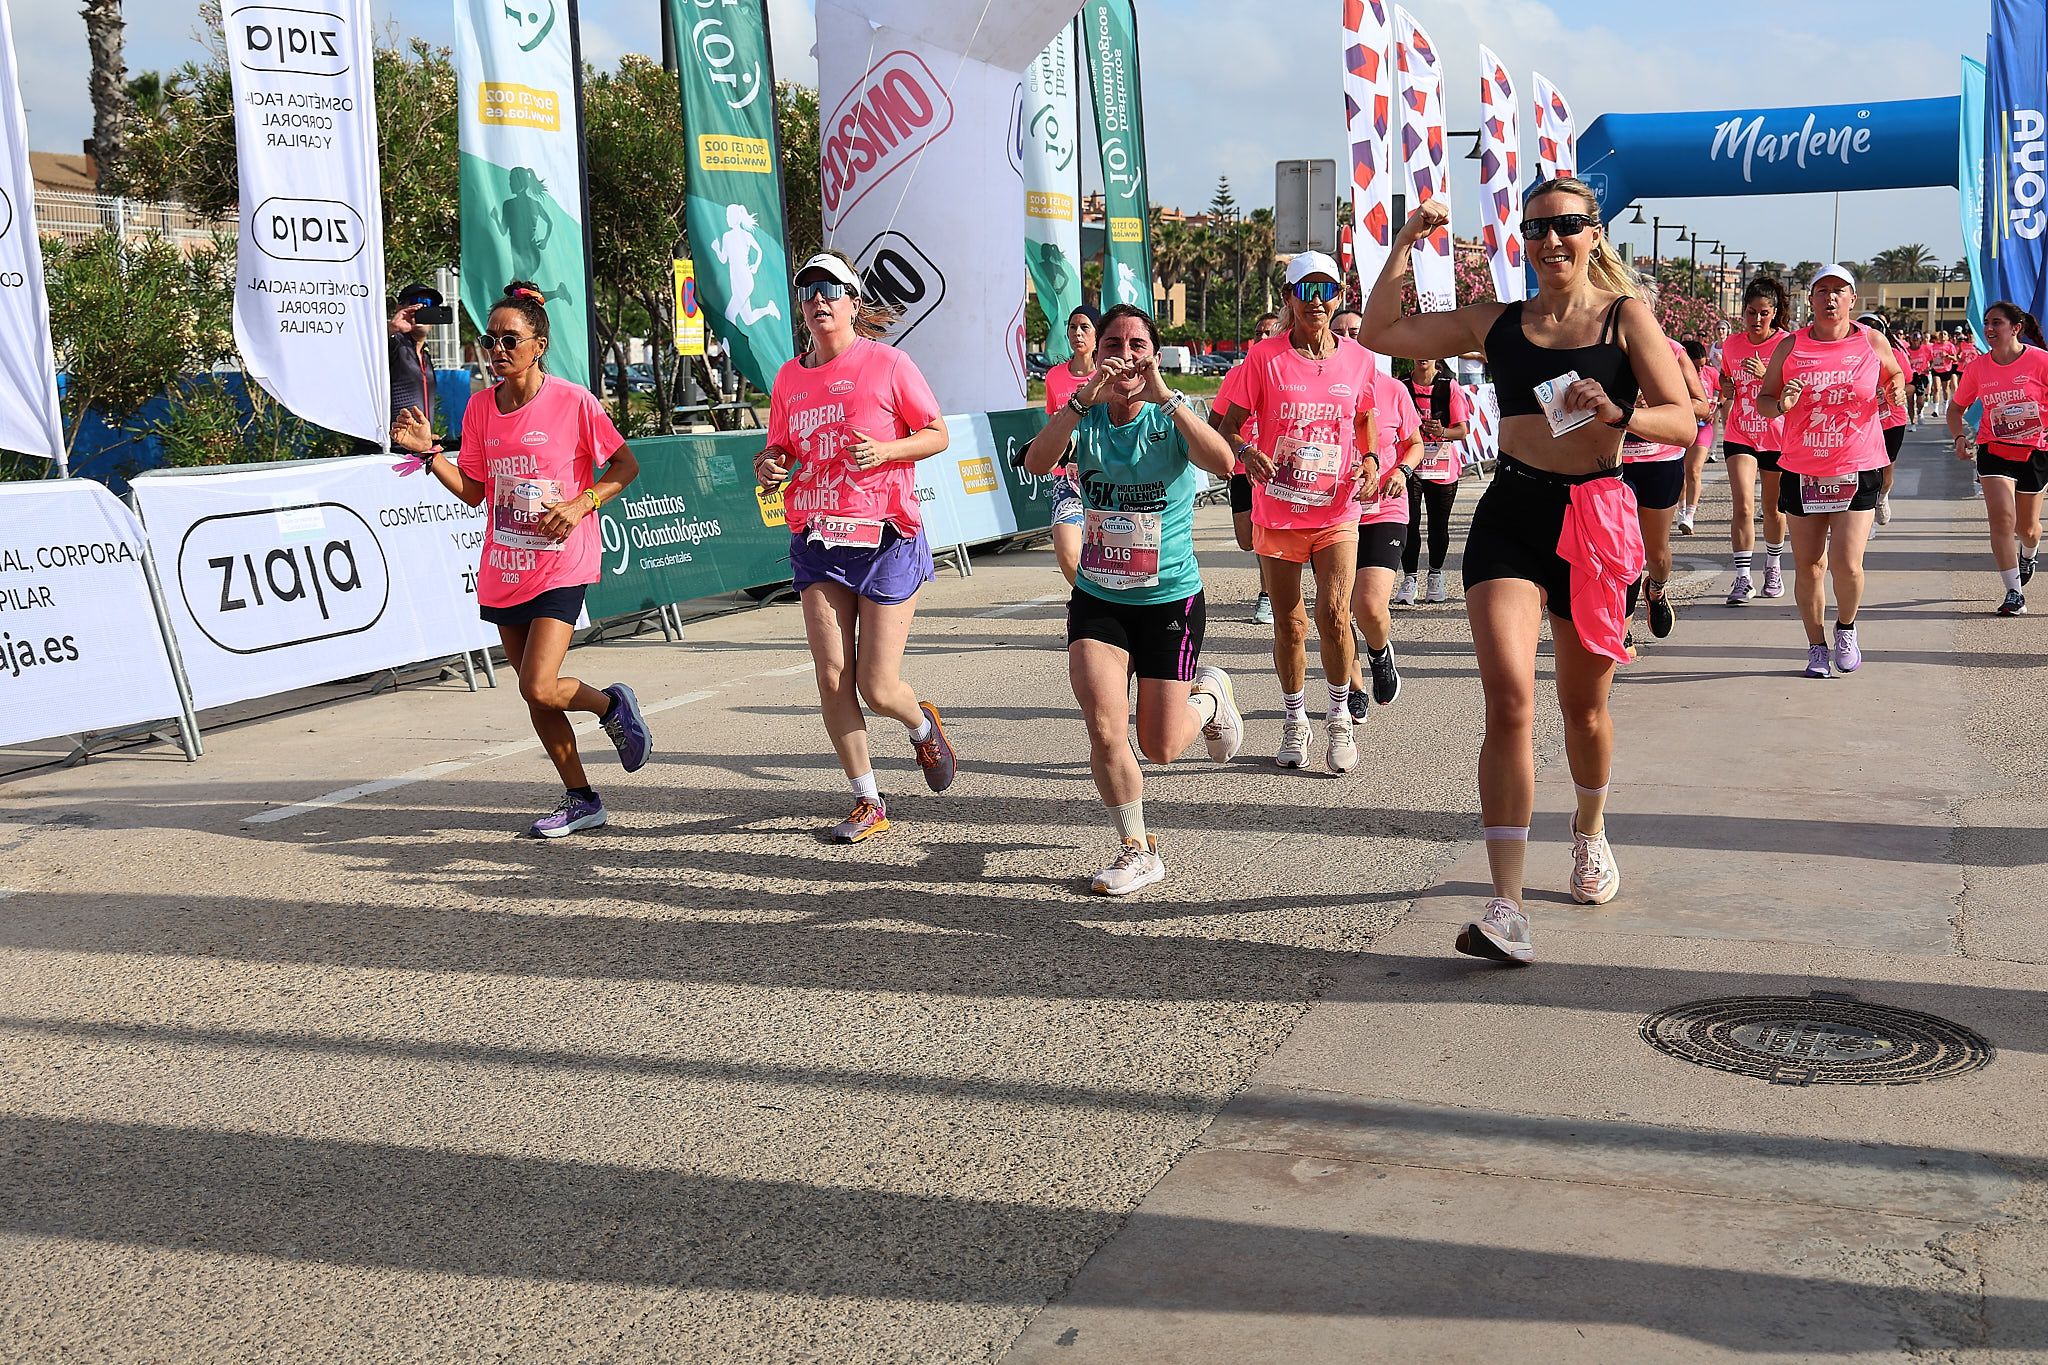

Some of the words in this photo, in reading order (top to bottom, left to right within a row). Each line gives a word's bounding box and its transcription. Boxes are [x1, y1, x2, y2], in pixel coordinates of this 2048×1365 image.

[821, 68, 934, 212] COSMO
[1799, 371, 1854, 386] CARRERA
[1983, 389, 2027, 406] CARRERA
[789, 402, 846, 434] CARRERA
[1280, 402, 1342, 420] CARRERA
[1802, 431, 1844, 448] MUJER
[1293, 469, 1318, 482] 016
[1117, 480, 1165, 493] NOCTURNA
[1117, 488, 1168, 502] VALENCIA
[1819, 484, 1840, 494] 016
[620, 493, 686, 521] Institutos
[794, 488, 840, 511] MUJER
[379, 501, 455, 527] COSMÉTICA
[513, 509, 540, 522] 016
[630, 515, 722, 550] Odontológicos
[826, 522, 857, 533] 016
[450, 533, 460, 550] Y
[36, 541, 140, 569] CORPORA
[488, 550, 537, 571] MUJER
[663, 550, 693, 568] dentales
[1104, 547, 1132, 561] 016
[208, 540, 362, 620] ziaja
[501, 572, 520, 584] 2026
